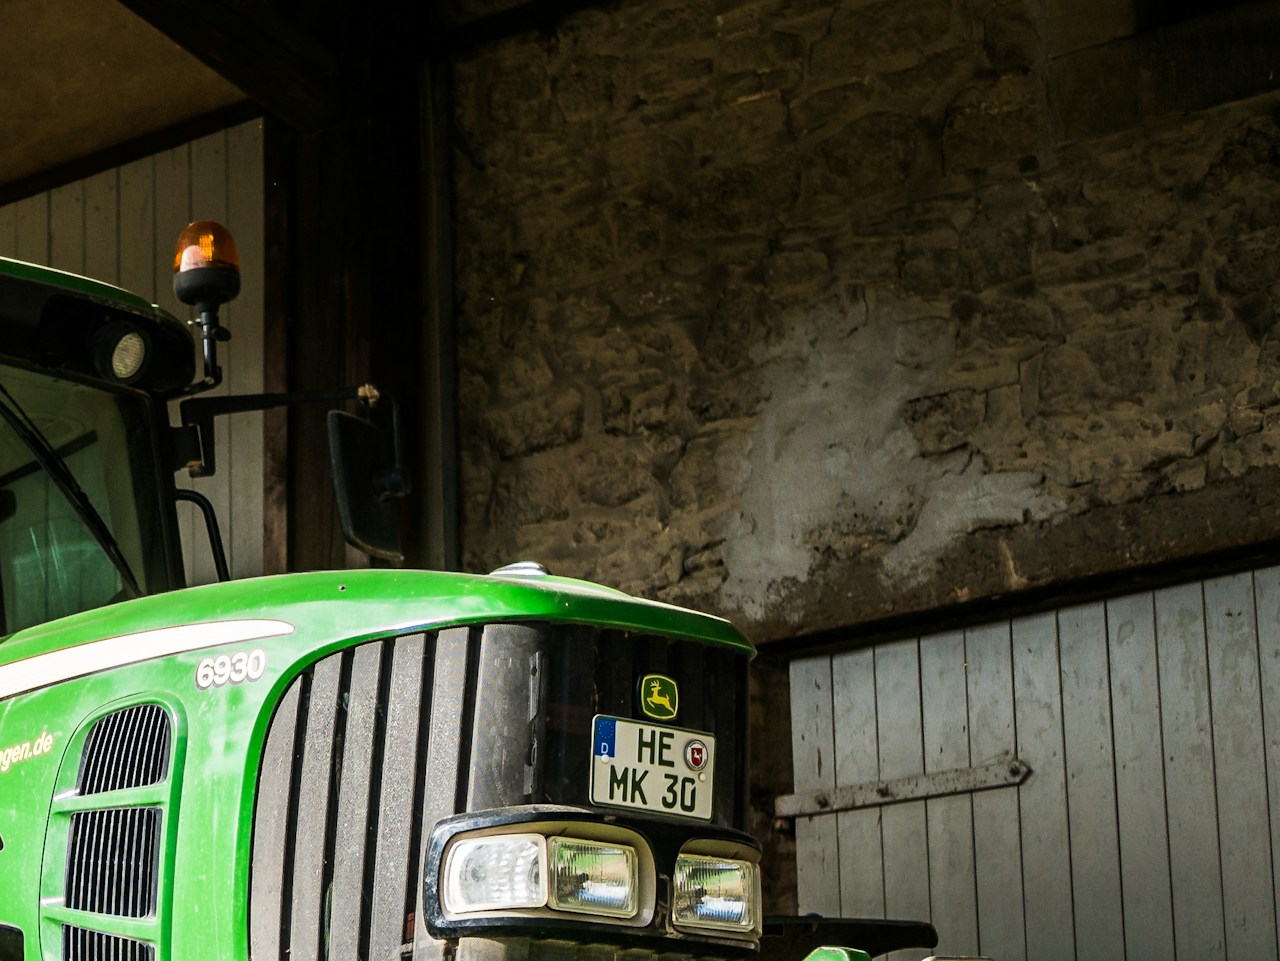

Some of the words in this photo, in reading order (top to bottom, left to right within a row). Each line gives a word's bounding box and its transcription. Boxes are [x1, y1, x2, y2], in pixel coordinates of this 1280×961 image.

[196, 649, 266, 690] 6930
[600, 742, 609, 754] D
[637, 728, 675, 767] HE
[608, 764, 649, 806] MK
[661, 773, 697, 813] 30
